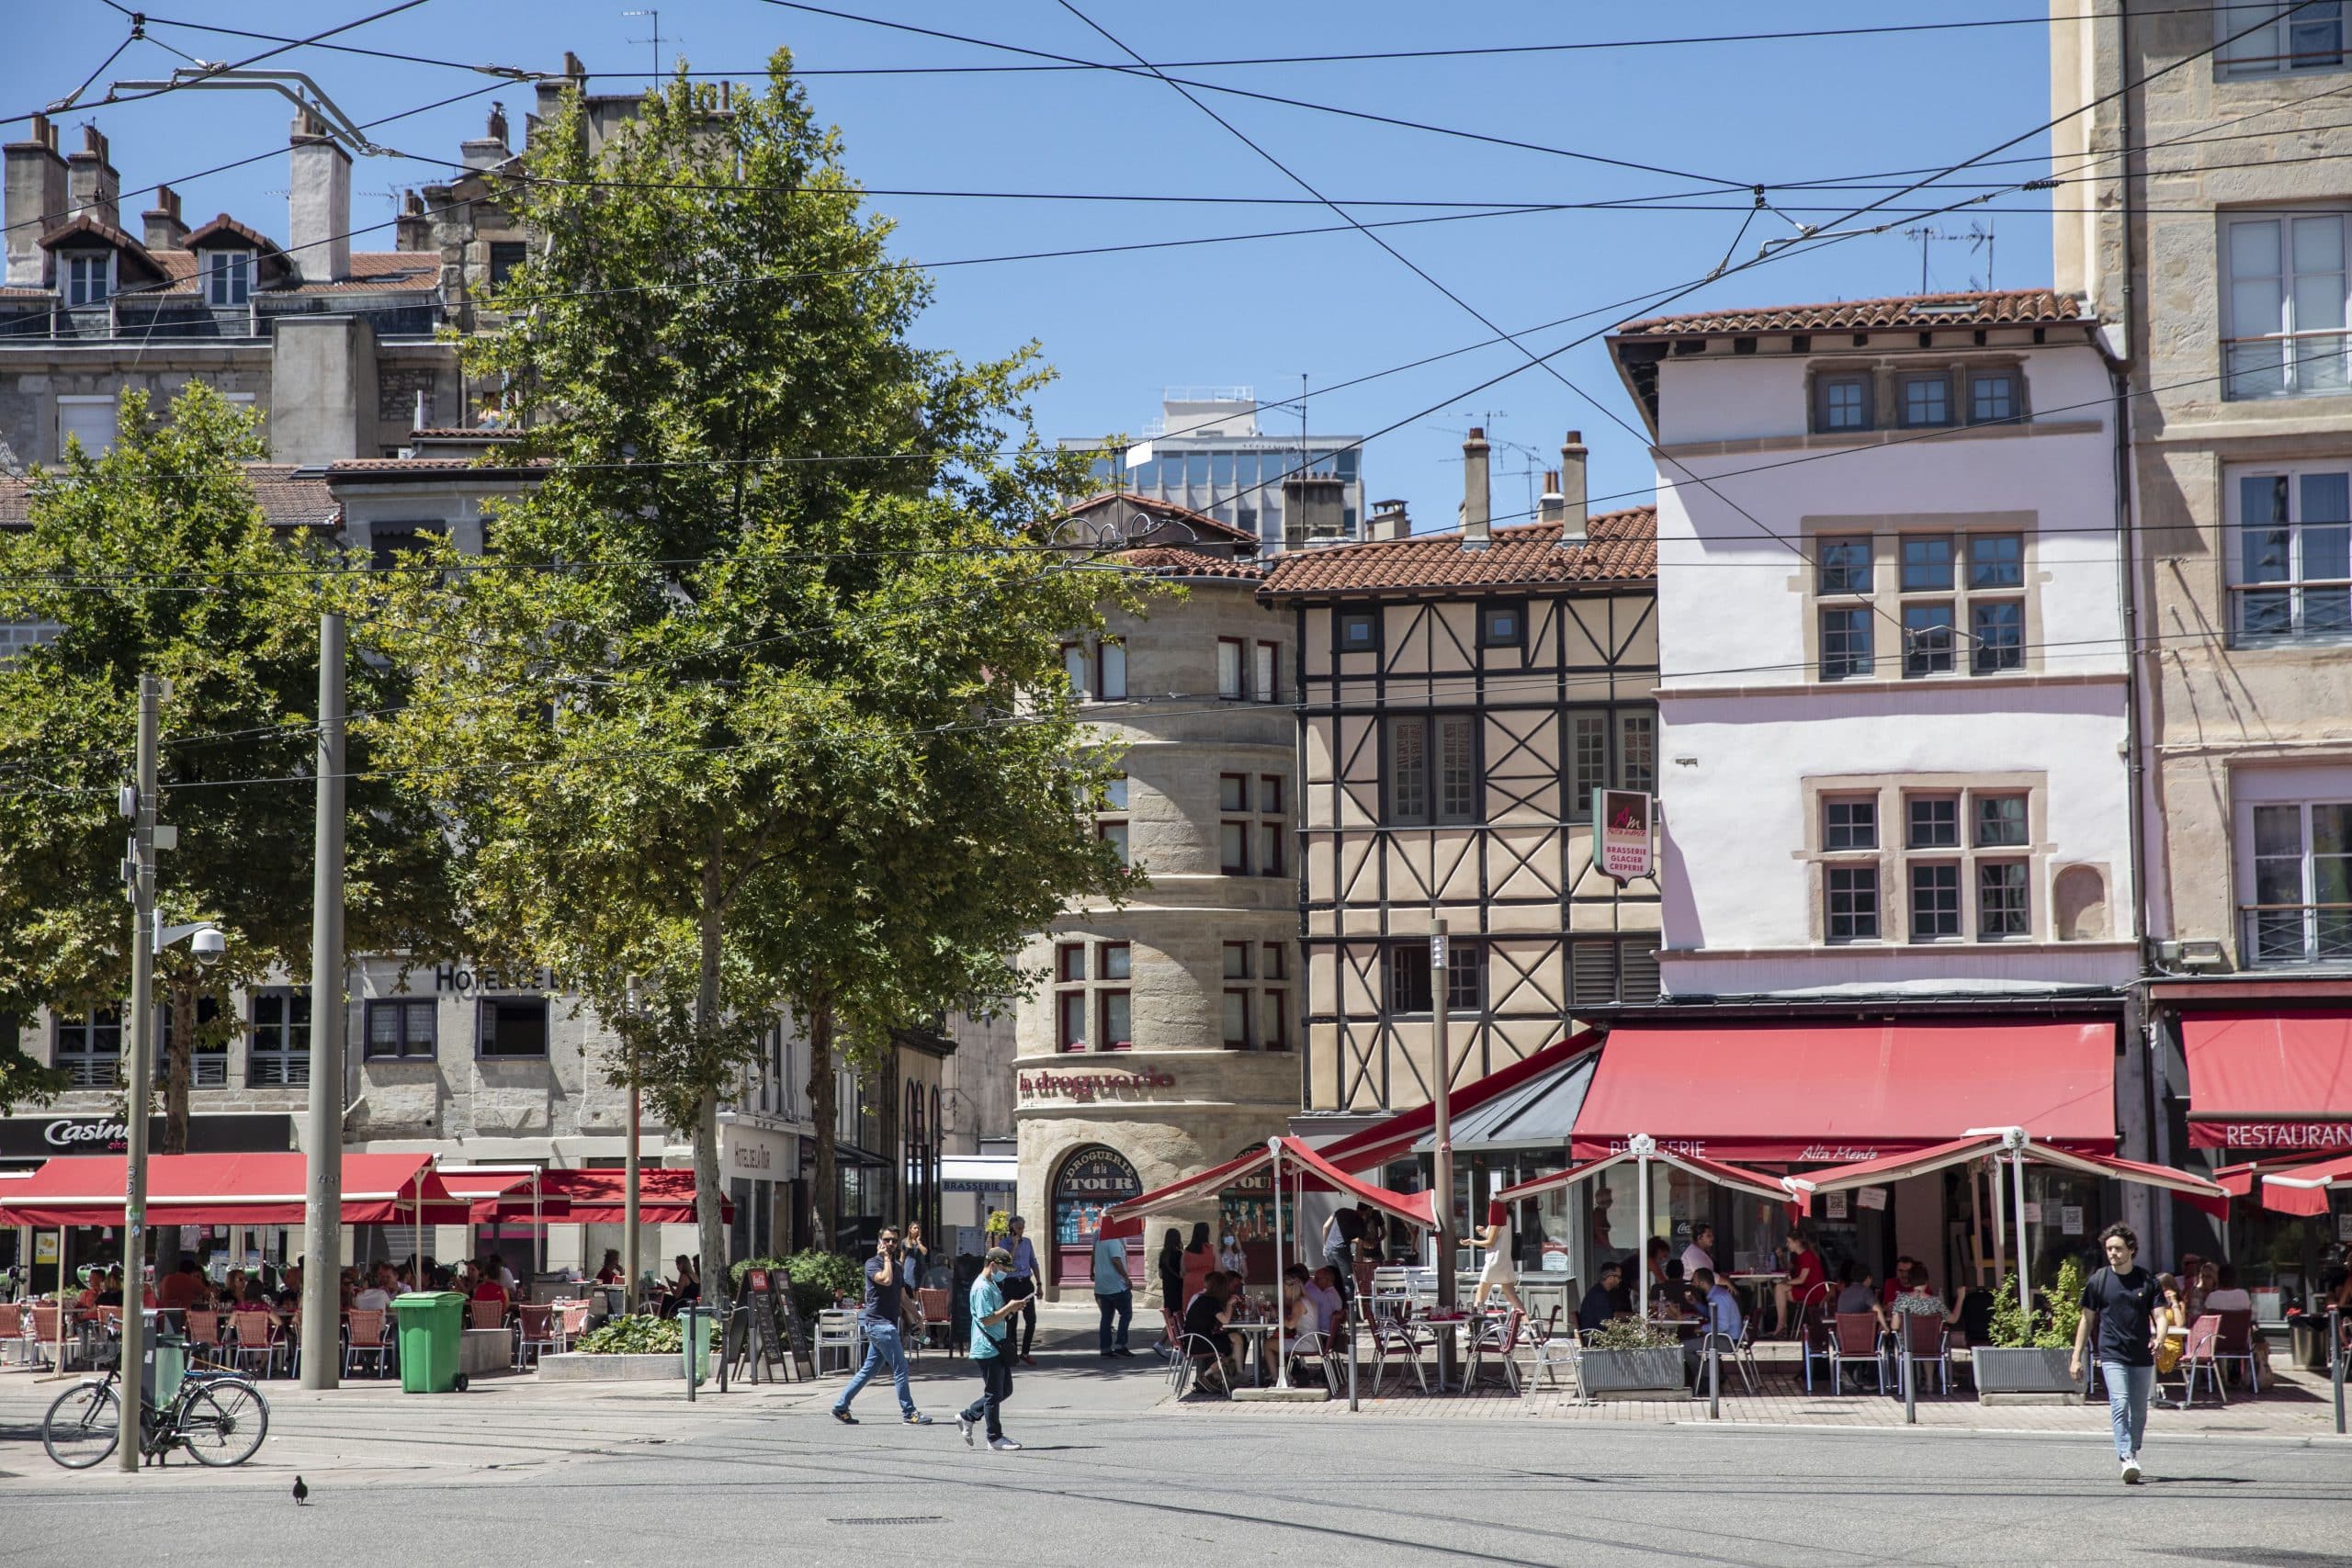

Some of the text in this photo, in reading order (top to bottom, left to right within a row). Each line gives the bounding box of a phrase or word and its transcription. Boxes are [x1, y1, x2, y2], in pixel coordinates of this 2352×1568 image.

[1607, 846, 1647, 855] BRASSERIE
[1611, 855, 1643, 863] GLACIER
[1610, 863, 1644, 872] CREPERIE
[1035, 1065, 1176, 1100] droguerie
[44, 1119, 129, 1145] Casin
[1798, 1143, 1879, 1161] Alta Mente
[1066, 1151, 1134, 1179] DROGUERIE
[944, 1182, 1001, 1191] BRASSERIE
[1066, 1178, 1134, 1190] TOUR
